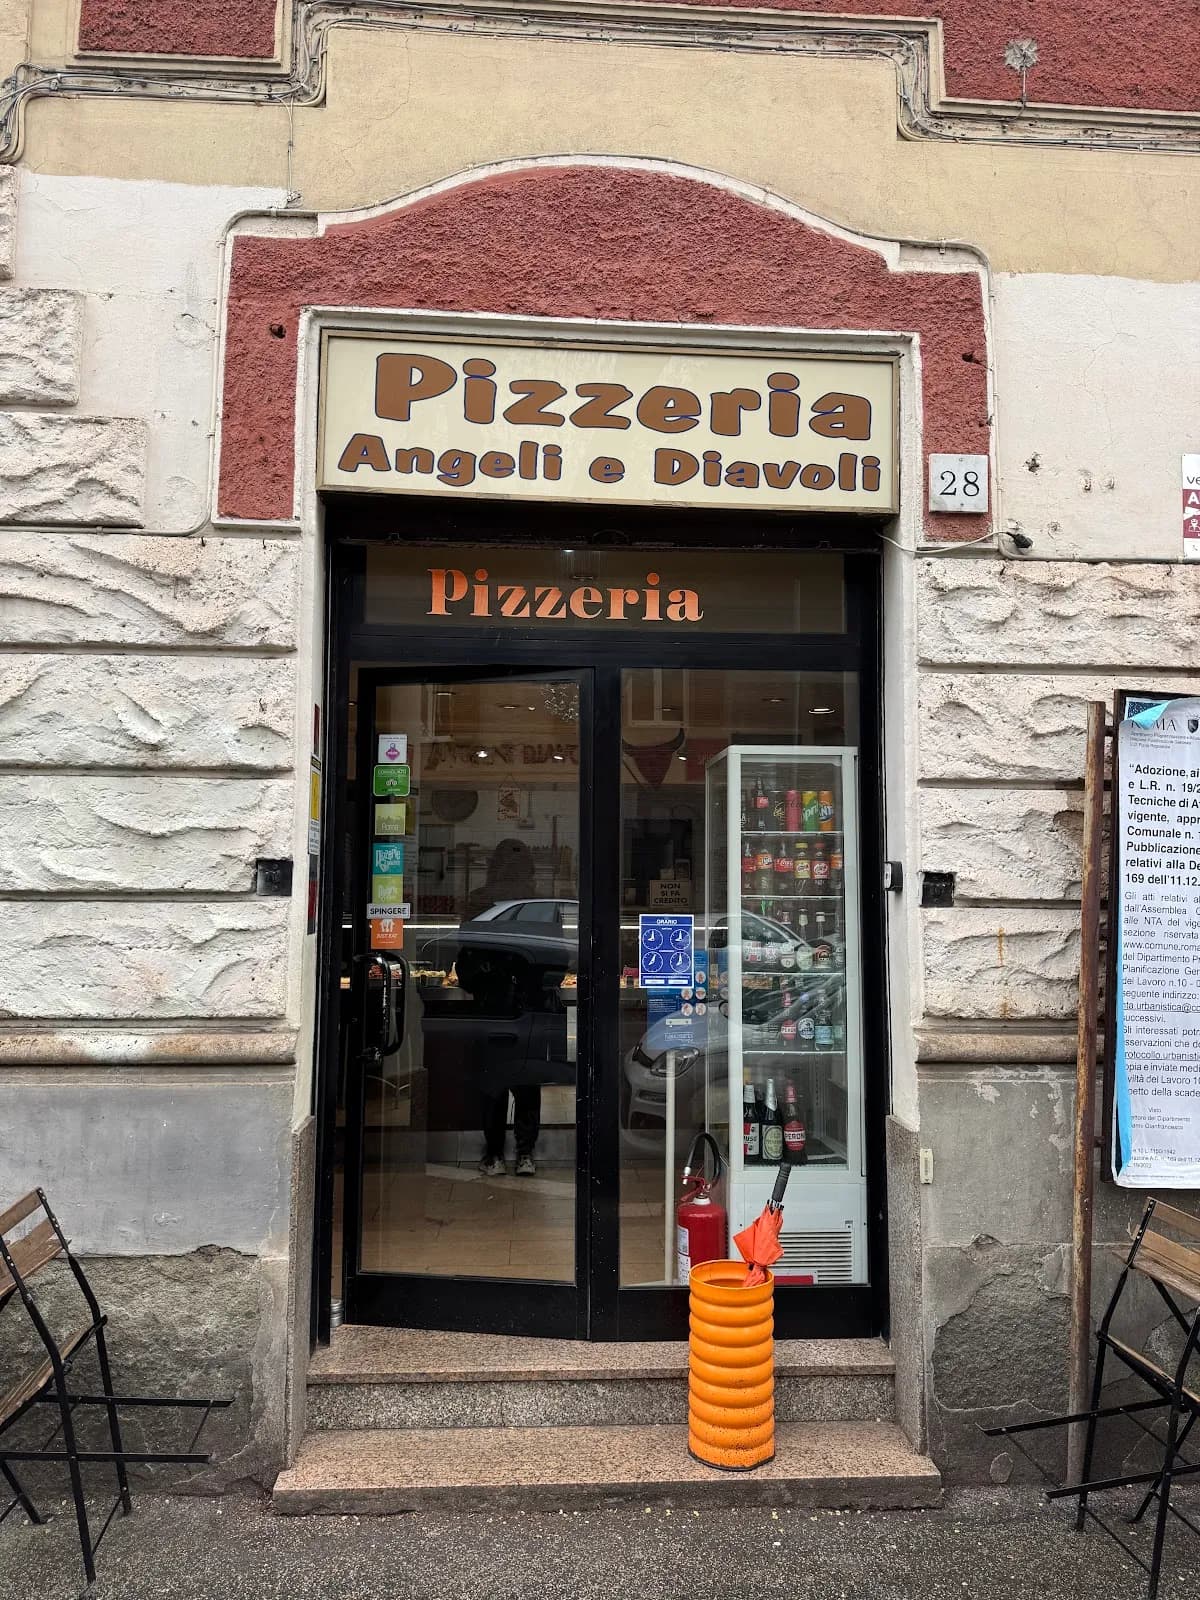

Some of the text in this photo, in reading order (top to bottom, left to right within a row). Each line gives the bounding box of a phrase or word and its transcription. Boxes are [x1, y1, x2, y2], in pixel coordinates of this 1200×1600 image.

[375, 353, 872, 441] Pizzeria
[338, 433, 881, 492] Angeli e Diavoli
[939, 470, 980, 497] 28
[426, 568, 705, 623] Pizzeria
[1128, 781, 1135, 789] e
[1140, 780, 1161, 791] L.R.
[1166, 784, 1176, 792] n.
[1128, 794, 1177, 808] Tecniche
[1178, 798, 1189, 808] di
[1128, 810, 1170, 824] vigente,
[1127, 825, 1194, 840] Comunale n.
[1126, 841, 1200, 856] Pubblicazione
[1126, 857, 1162, 868] relativi
[1166, 859, 1186, 870] alla
[1124, 872, 1145, 884] 169
[1124, 891, 1137, 900] Gli
[1160, 894, 1188, 903] relativi
[370, 907, 407, 915] SPINGERE
[1124, 904, 1187, 915] dall'Assemblea
[1124, 916, 1139, 925] alle
[1144, 916, 1163, 926] NTA
[1168, 918, 1180, 926] del
[1123, 928, 1199, 940] sezione riservata
[1122, 952, 1135, 961] del
[1137, 952, 1190, 964] Dipartimento
[1122, 964, 1180, 975] Pianificazione
[1138, 977, 1166, 986] Lavoro
[1162, 990, 1199, 1000] indirizzo:
[1136, 1026, 1178, 1035] interessati
[1174, 1040, 1190, 1048] che
[1150, 1062, 1178, 1072] inviate
[1162, 1076, 1191, 1085] Lavoro
[1152, 1087, 1172, 1097] della
